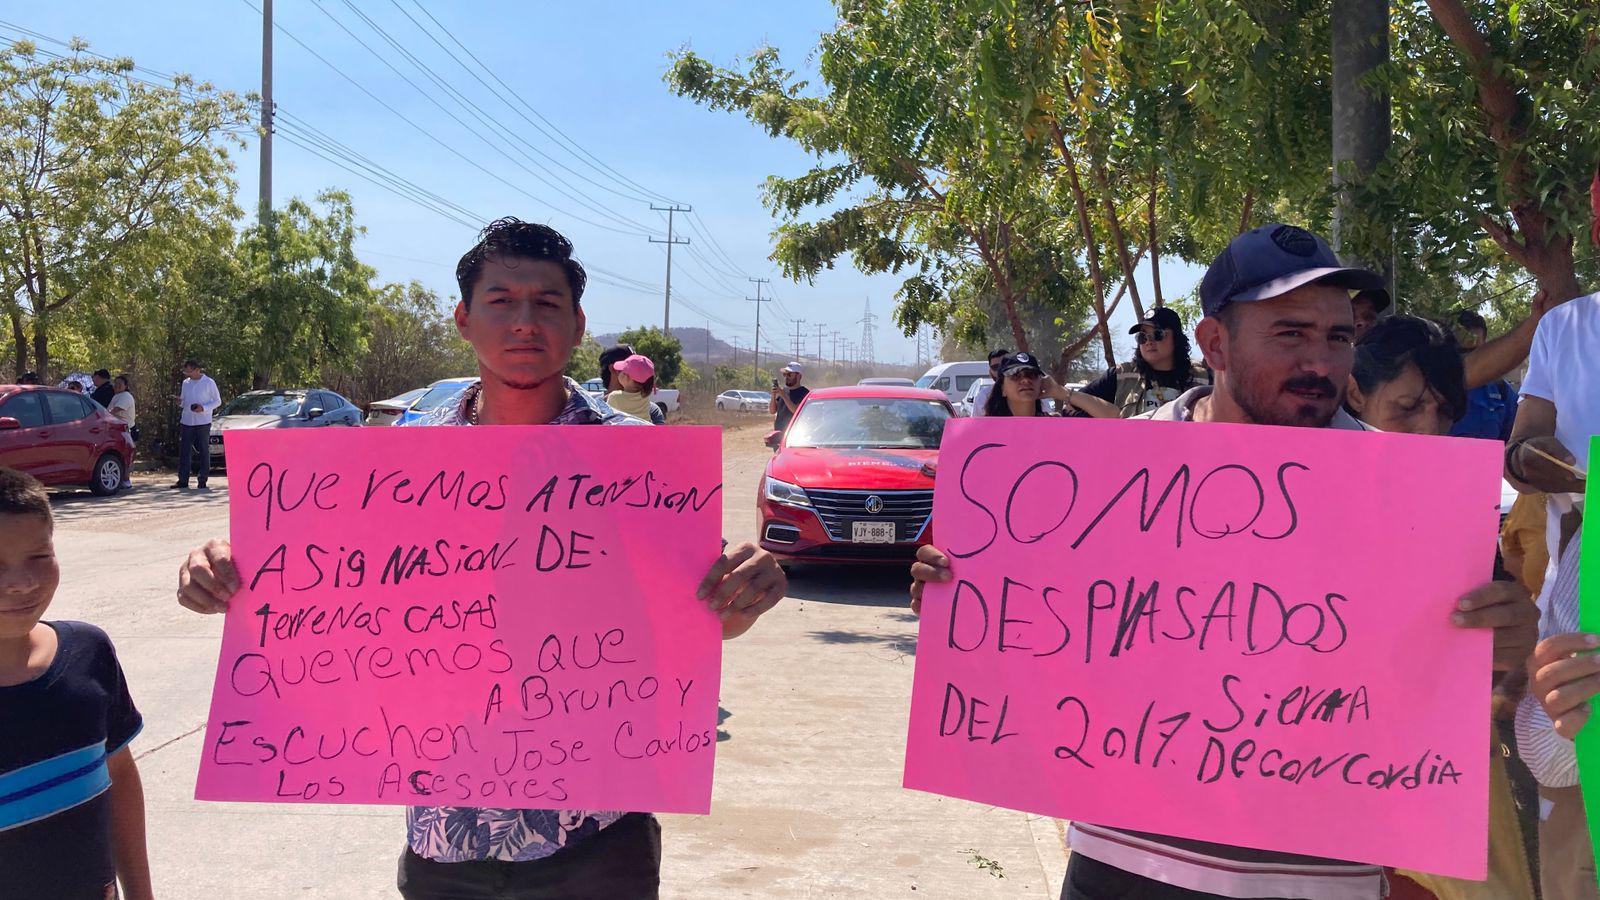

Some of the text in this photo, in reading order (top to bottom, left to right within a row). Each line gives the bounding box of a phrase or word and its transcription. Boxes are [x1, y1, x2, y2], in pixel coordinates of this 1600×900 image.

[948, 443, 1310, 559] SOMOS
[404, 594, 496, 633] CASAS
[232, 638, 513, 699] Queremos
[484, 683, 503, 725] A
[521, 675, 658, 720] Bruno
[940, 683, 1018, 744] DEL
[214, 707, 711, 776] Escuchen Jose Carlos
[277, 770, 344, 800] Los
